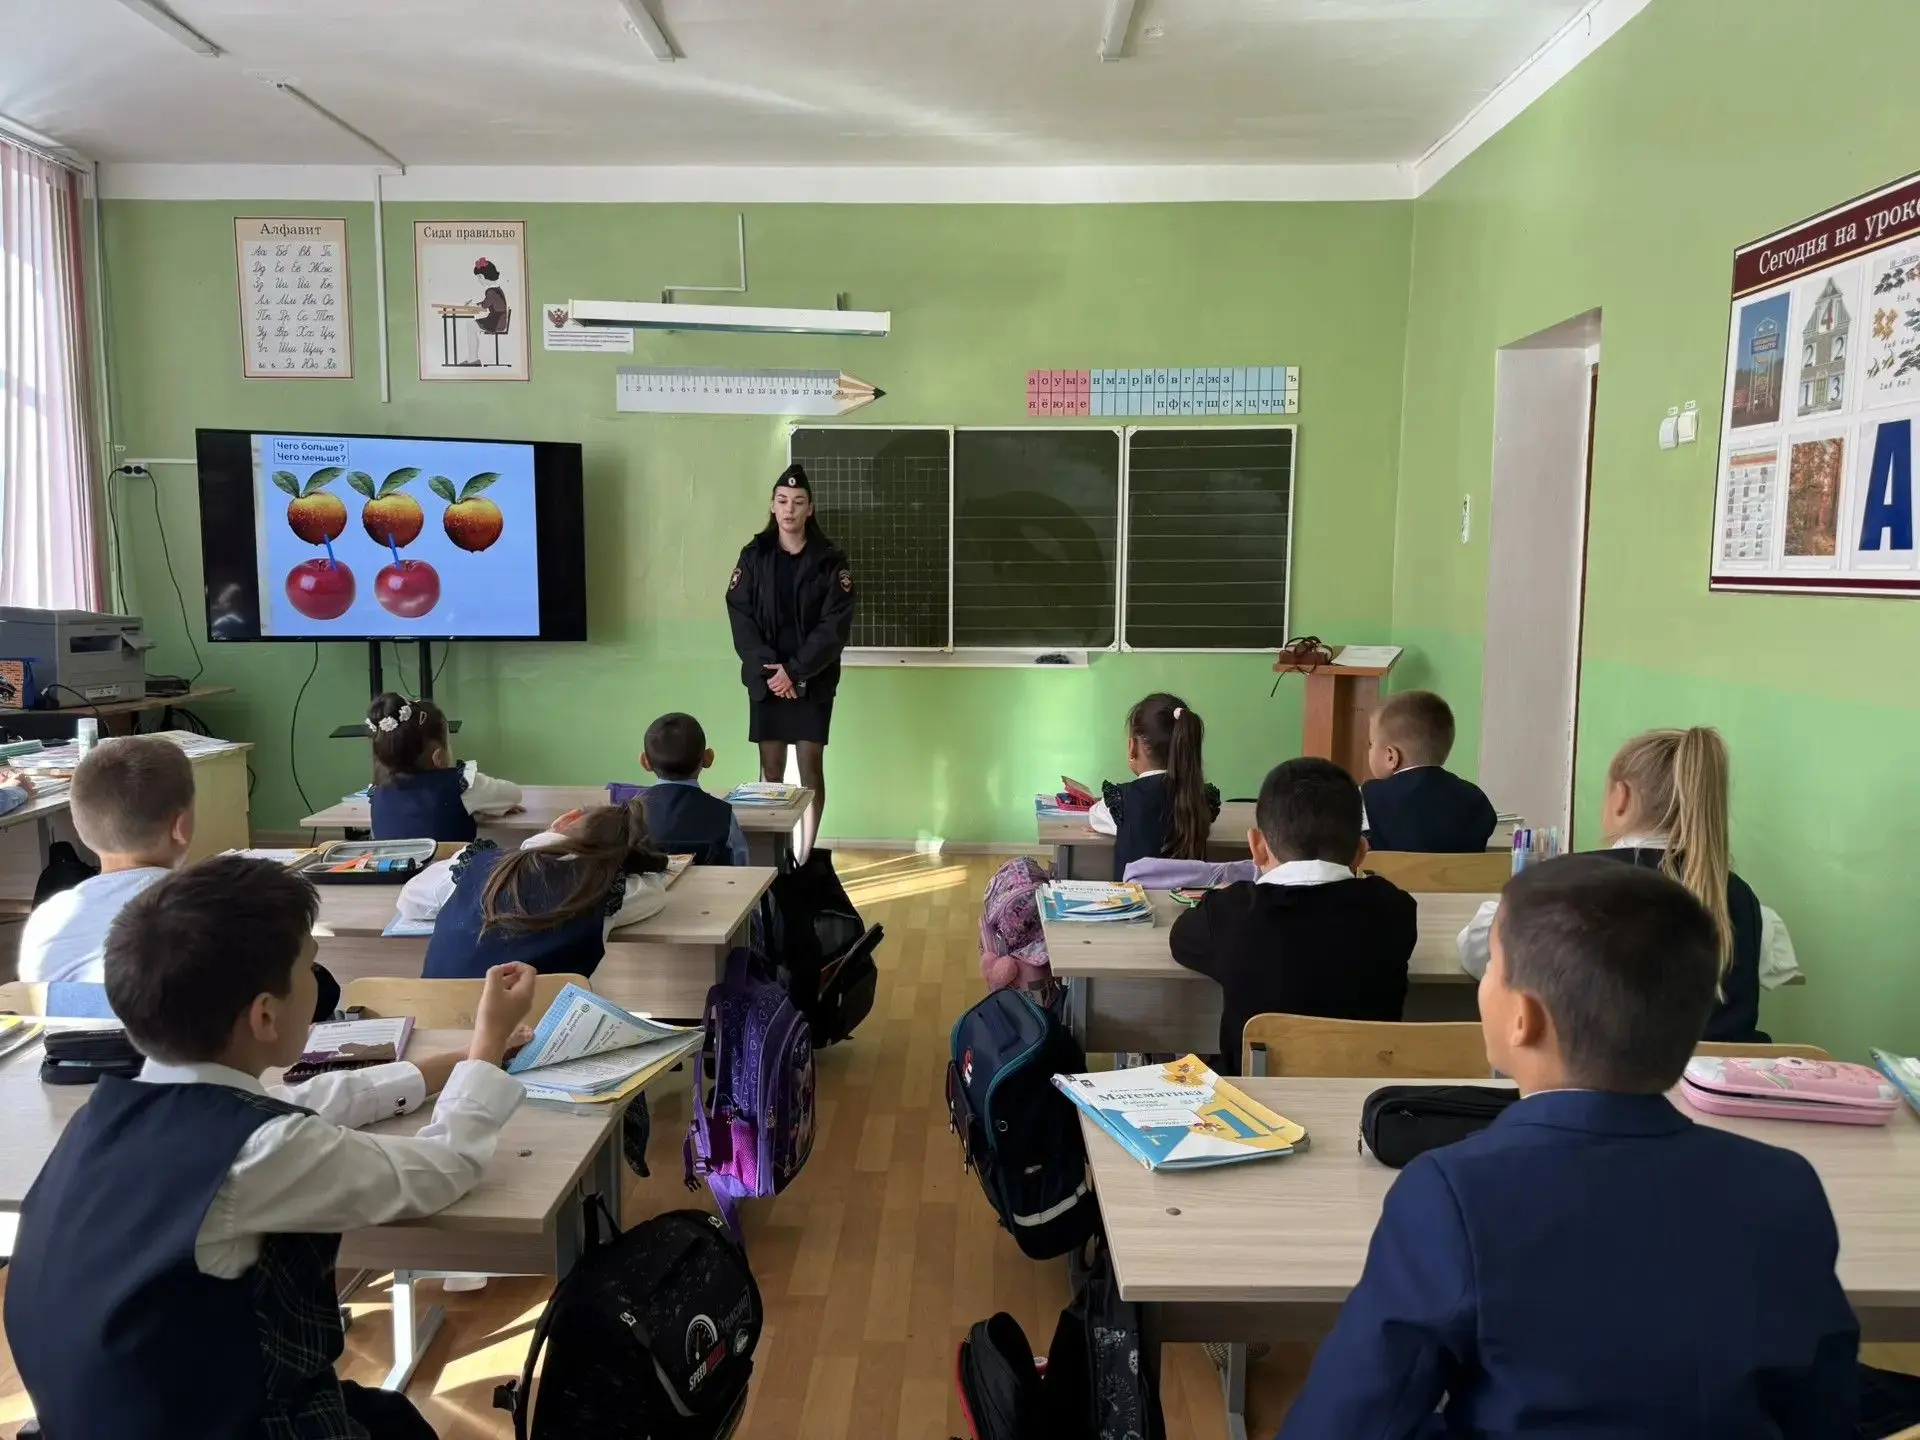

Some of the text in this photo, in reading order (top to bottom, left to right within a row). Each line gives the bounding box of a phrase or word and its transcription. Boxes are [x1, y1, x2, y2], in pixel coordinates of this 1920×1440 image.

[260, 223, 322, 237] Алфавит
[423, 226, 516, 240] Сиди правильно
[1759, 232, 1829, 275] Сегодня
[1834, 222, 1857, 247] на
[1820, 298, 1833, 330] 4
[1804, 336, 1844, 368] 2 2
[1054, 378, 1062, 386] у
[1080, 377, 1087, 385] э
[1092, 377, 1100, 385] н
[1106, 377, 1115, 385] м
[1118, 377, 1126, 385] л
[1131, 377, 1140, 386] р
[1144, 375, 1153, 385] й
[1157, 374, 1165, 384] б
[1196, 376, 1204, 385] д
[1208, 376, 1219, 384] ж
[1223, 376, 1230, 384] з
[1805, 376, 1841, 406] 1 3
[1028, 401, 1037, 409] я
[1041, 398, 1049, 409] ё
[1168, 399, 1178, 410] ф
[1196, 400, 1204, 408] т
[1207, 400, 1219, 408] ш
[1248, 400, 1257, 408] ц
[1273, 400, 1285, 408] щ
[1288, 398, 1296, 406] ь
[277, 441, 345, 452] Чего больше?
[277, 452, 346, 463] Чего меньше?
[1858, 419, 1913, 551] А
[1097, 1090, 1205, 1102] Математика
[689, 1360, 707, 1391] SPEED
